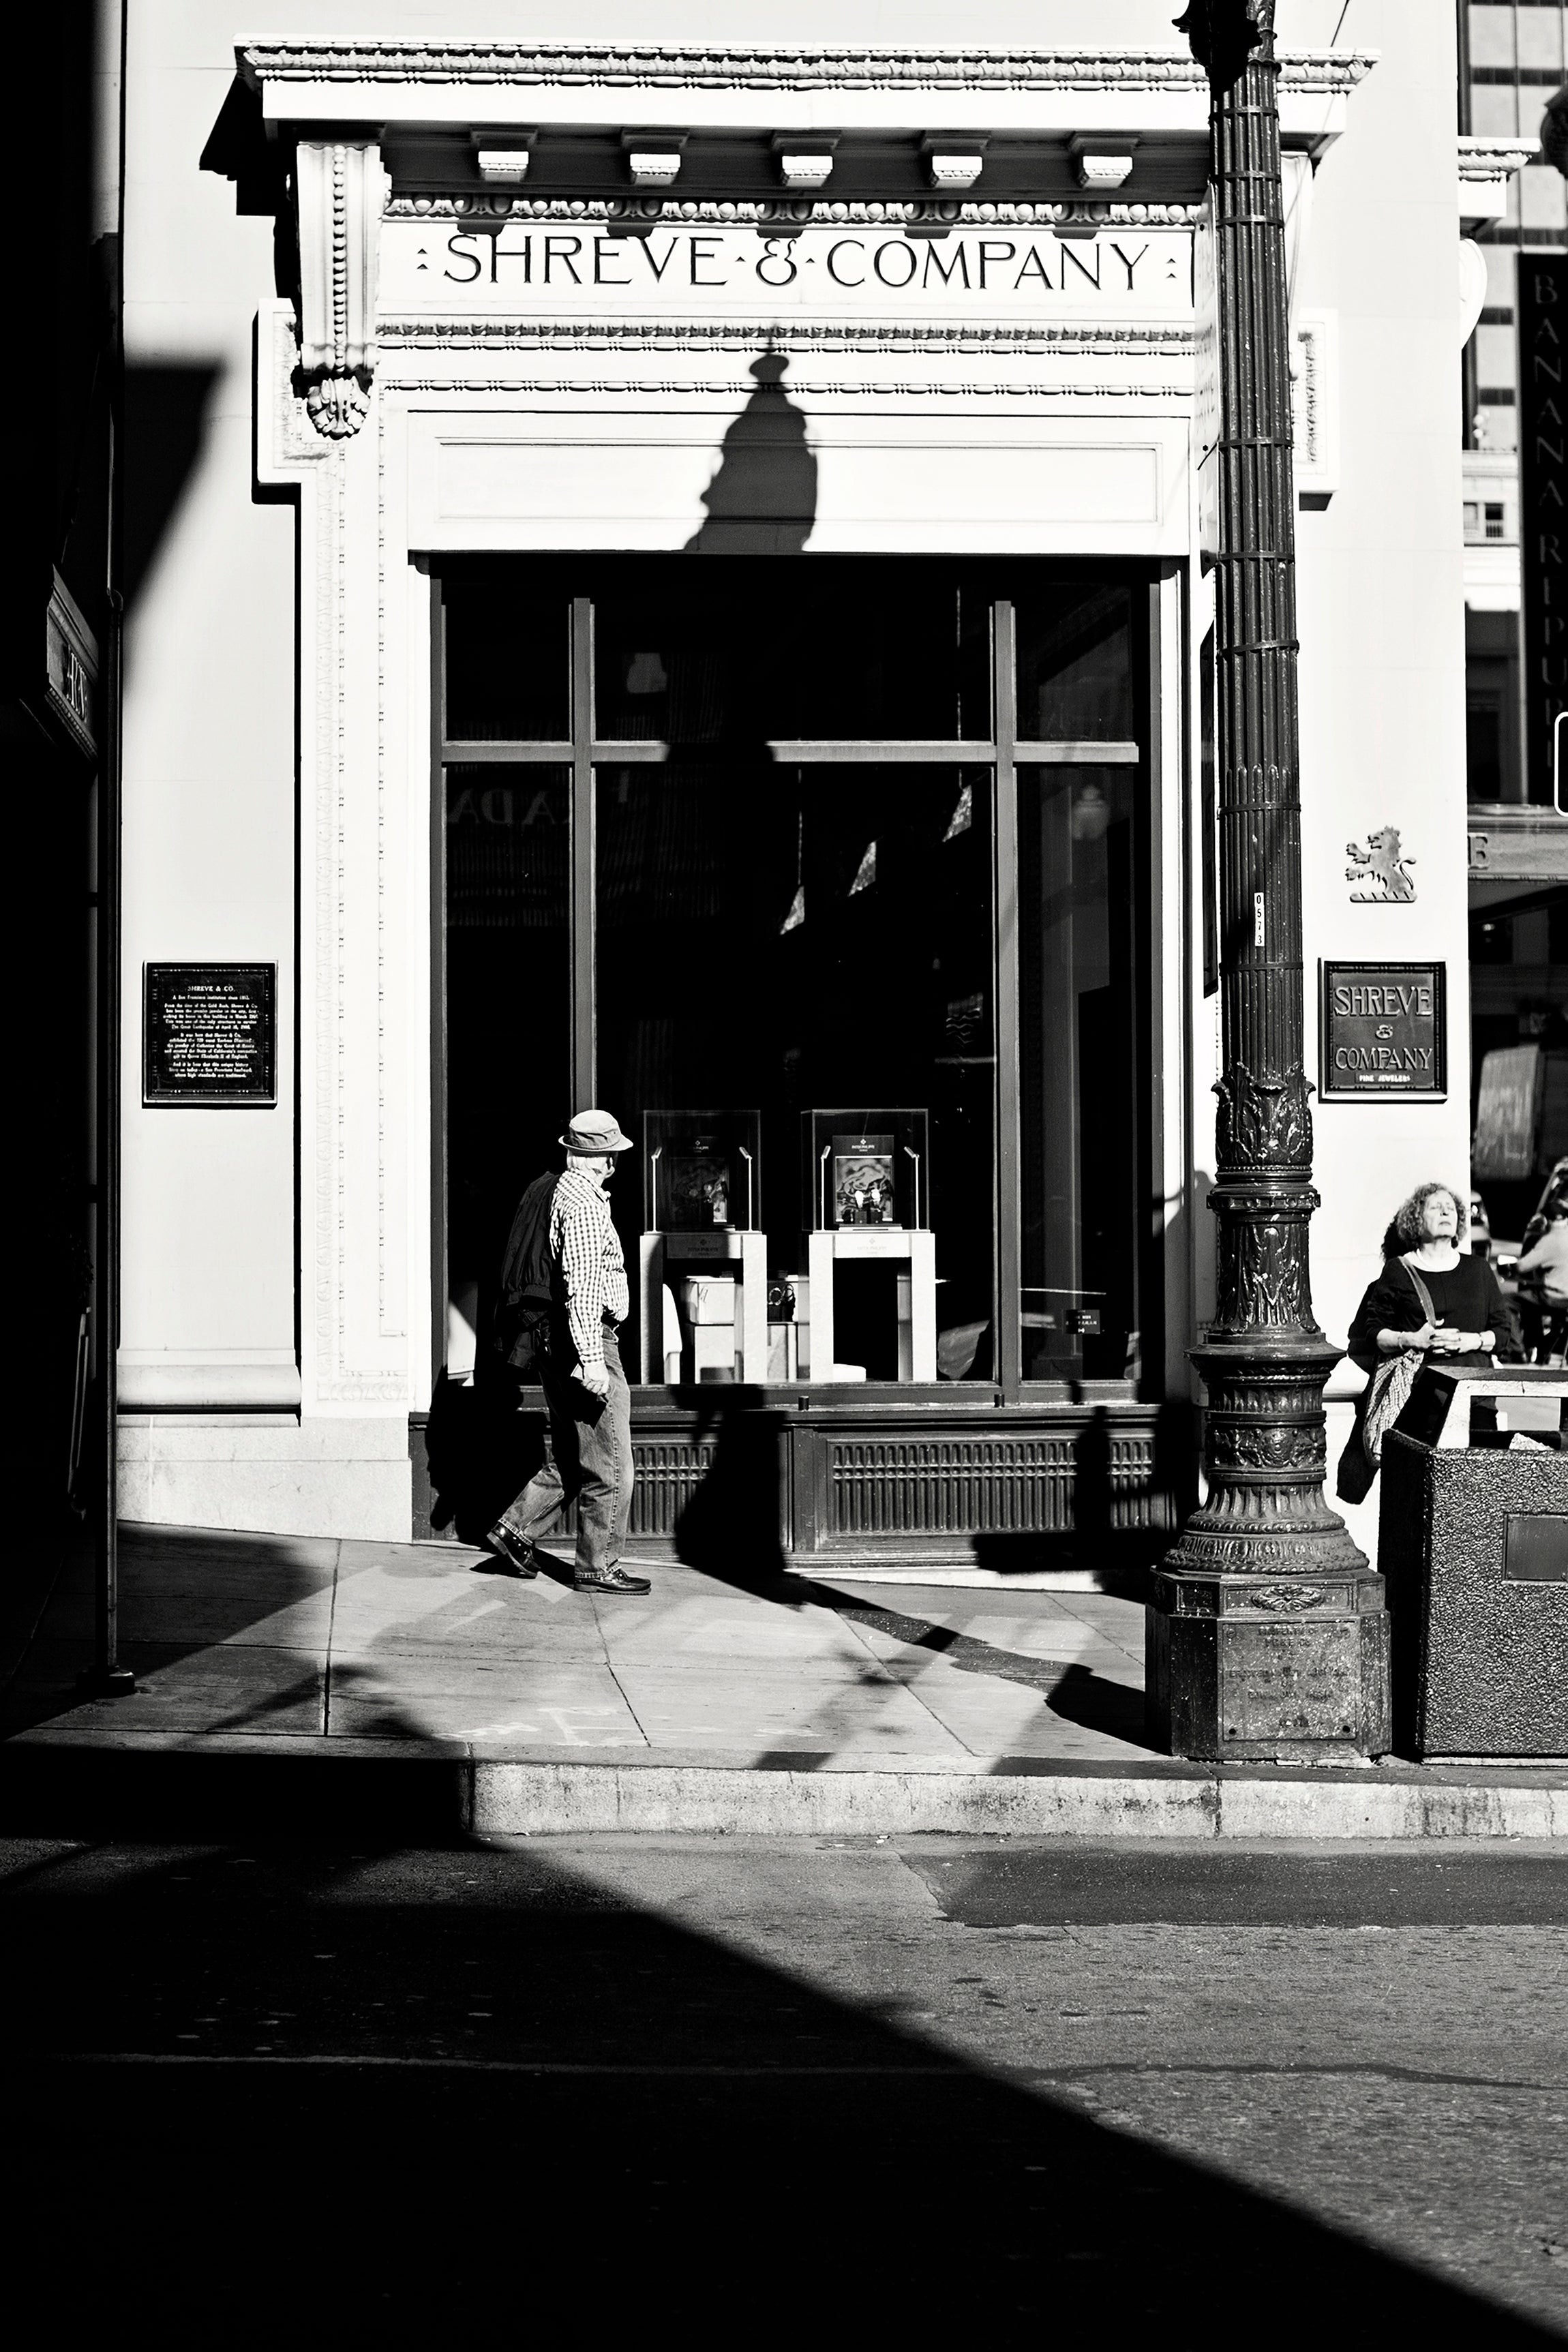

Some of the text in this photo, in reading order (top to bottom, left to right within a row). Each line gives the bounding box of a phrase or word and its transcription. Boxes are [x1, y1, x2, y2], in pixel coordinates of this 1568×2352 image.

[443, 235, 728, 286] SHREVE
[826, 239, 1150, 290] COMPANY
[1534, 273, 1565, 506] BANANA
[1333, 986, 1433, 1016] SHREVE
[1375, 1024, 1393, 1040] &
[1335, 1047, 1432, 1070] COMPANY
